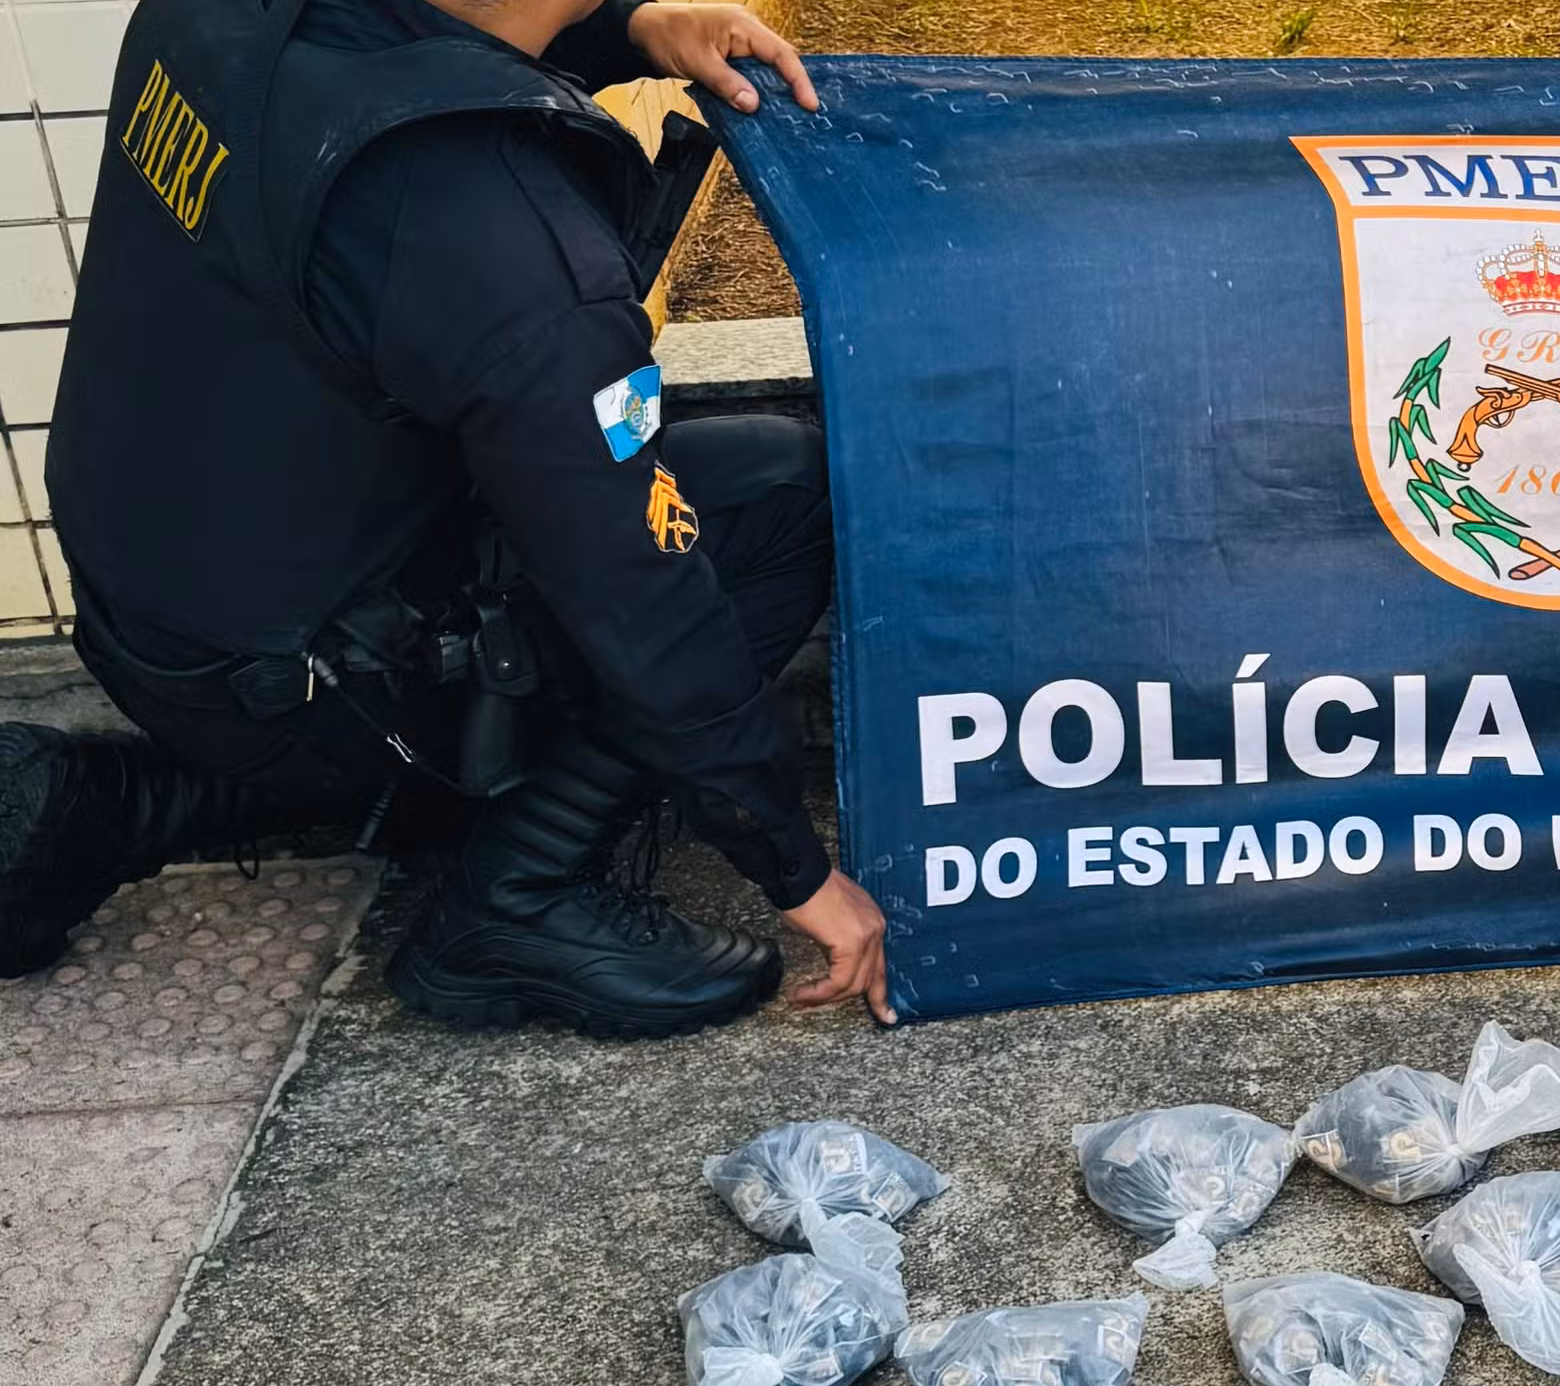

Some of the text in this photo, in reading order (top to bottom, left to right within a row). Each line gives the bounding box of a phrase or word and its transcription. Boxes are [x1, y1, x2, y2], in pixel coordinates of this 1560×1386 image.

[122, 60, 229, 230] PMERJ
[918, 654, 1543, 807] POLÍCIA
[927, 837, 1038, 907] DO
[1067, 817, 1384, 888] ESTADO
[1413, 814, 1521, 872] DO
